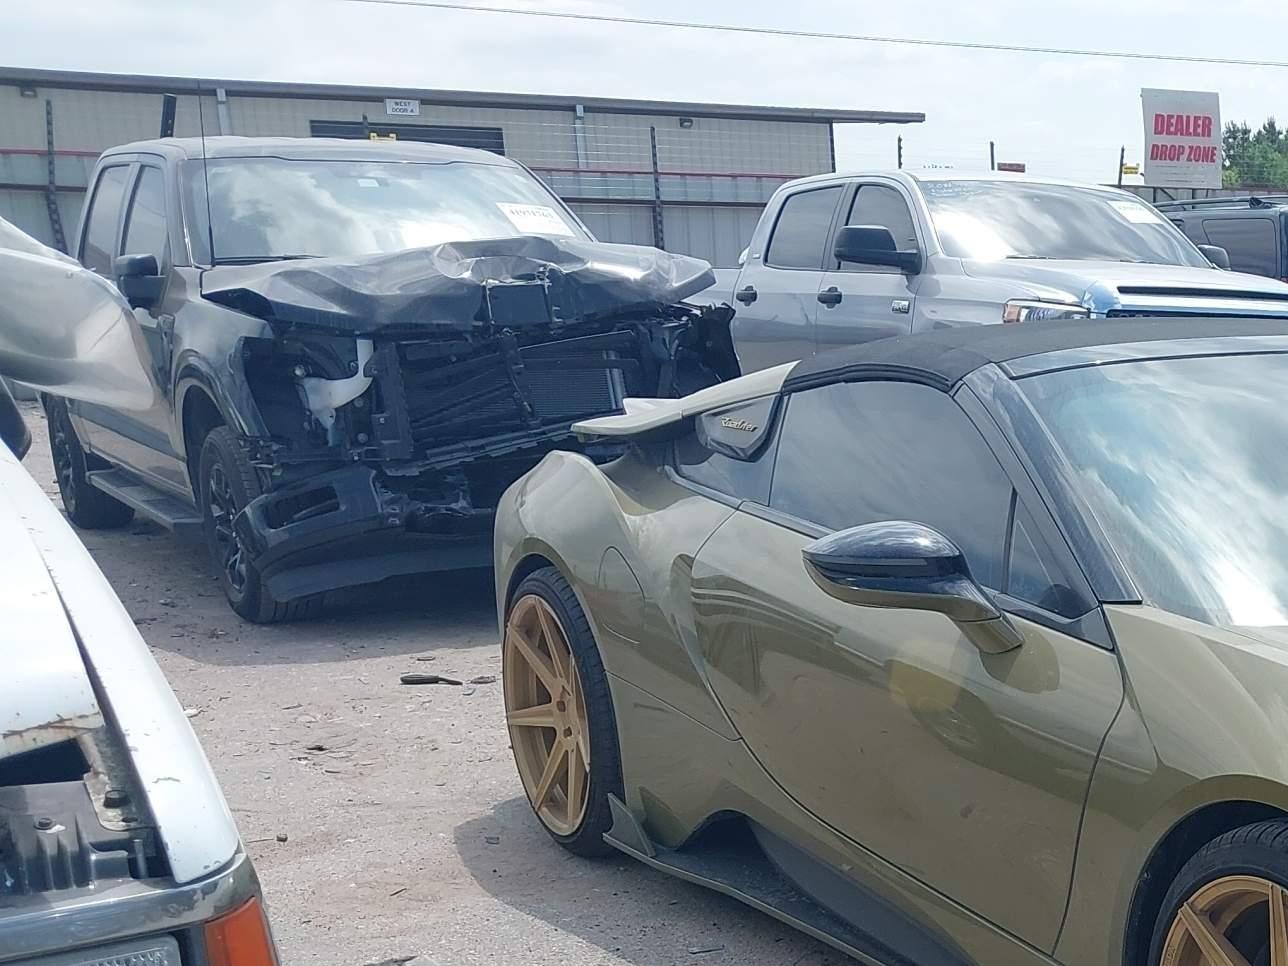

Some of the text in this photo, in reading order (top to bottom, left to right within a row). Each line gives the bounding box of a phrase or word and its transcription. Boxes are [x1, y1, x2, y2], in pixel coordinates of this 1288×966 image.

[1153, 113, 1212, 138] DEALER
[1150, 143, 1217, 163] DROP ZONE
